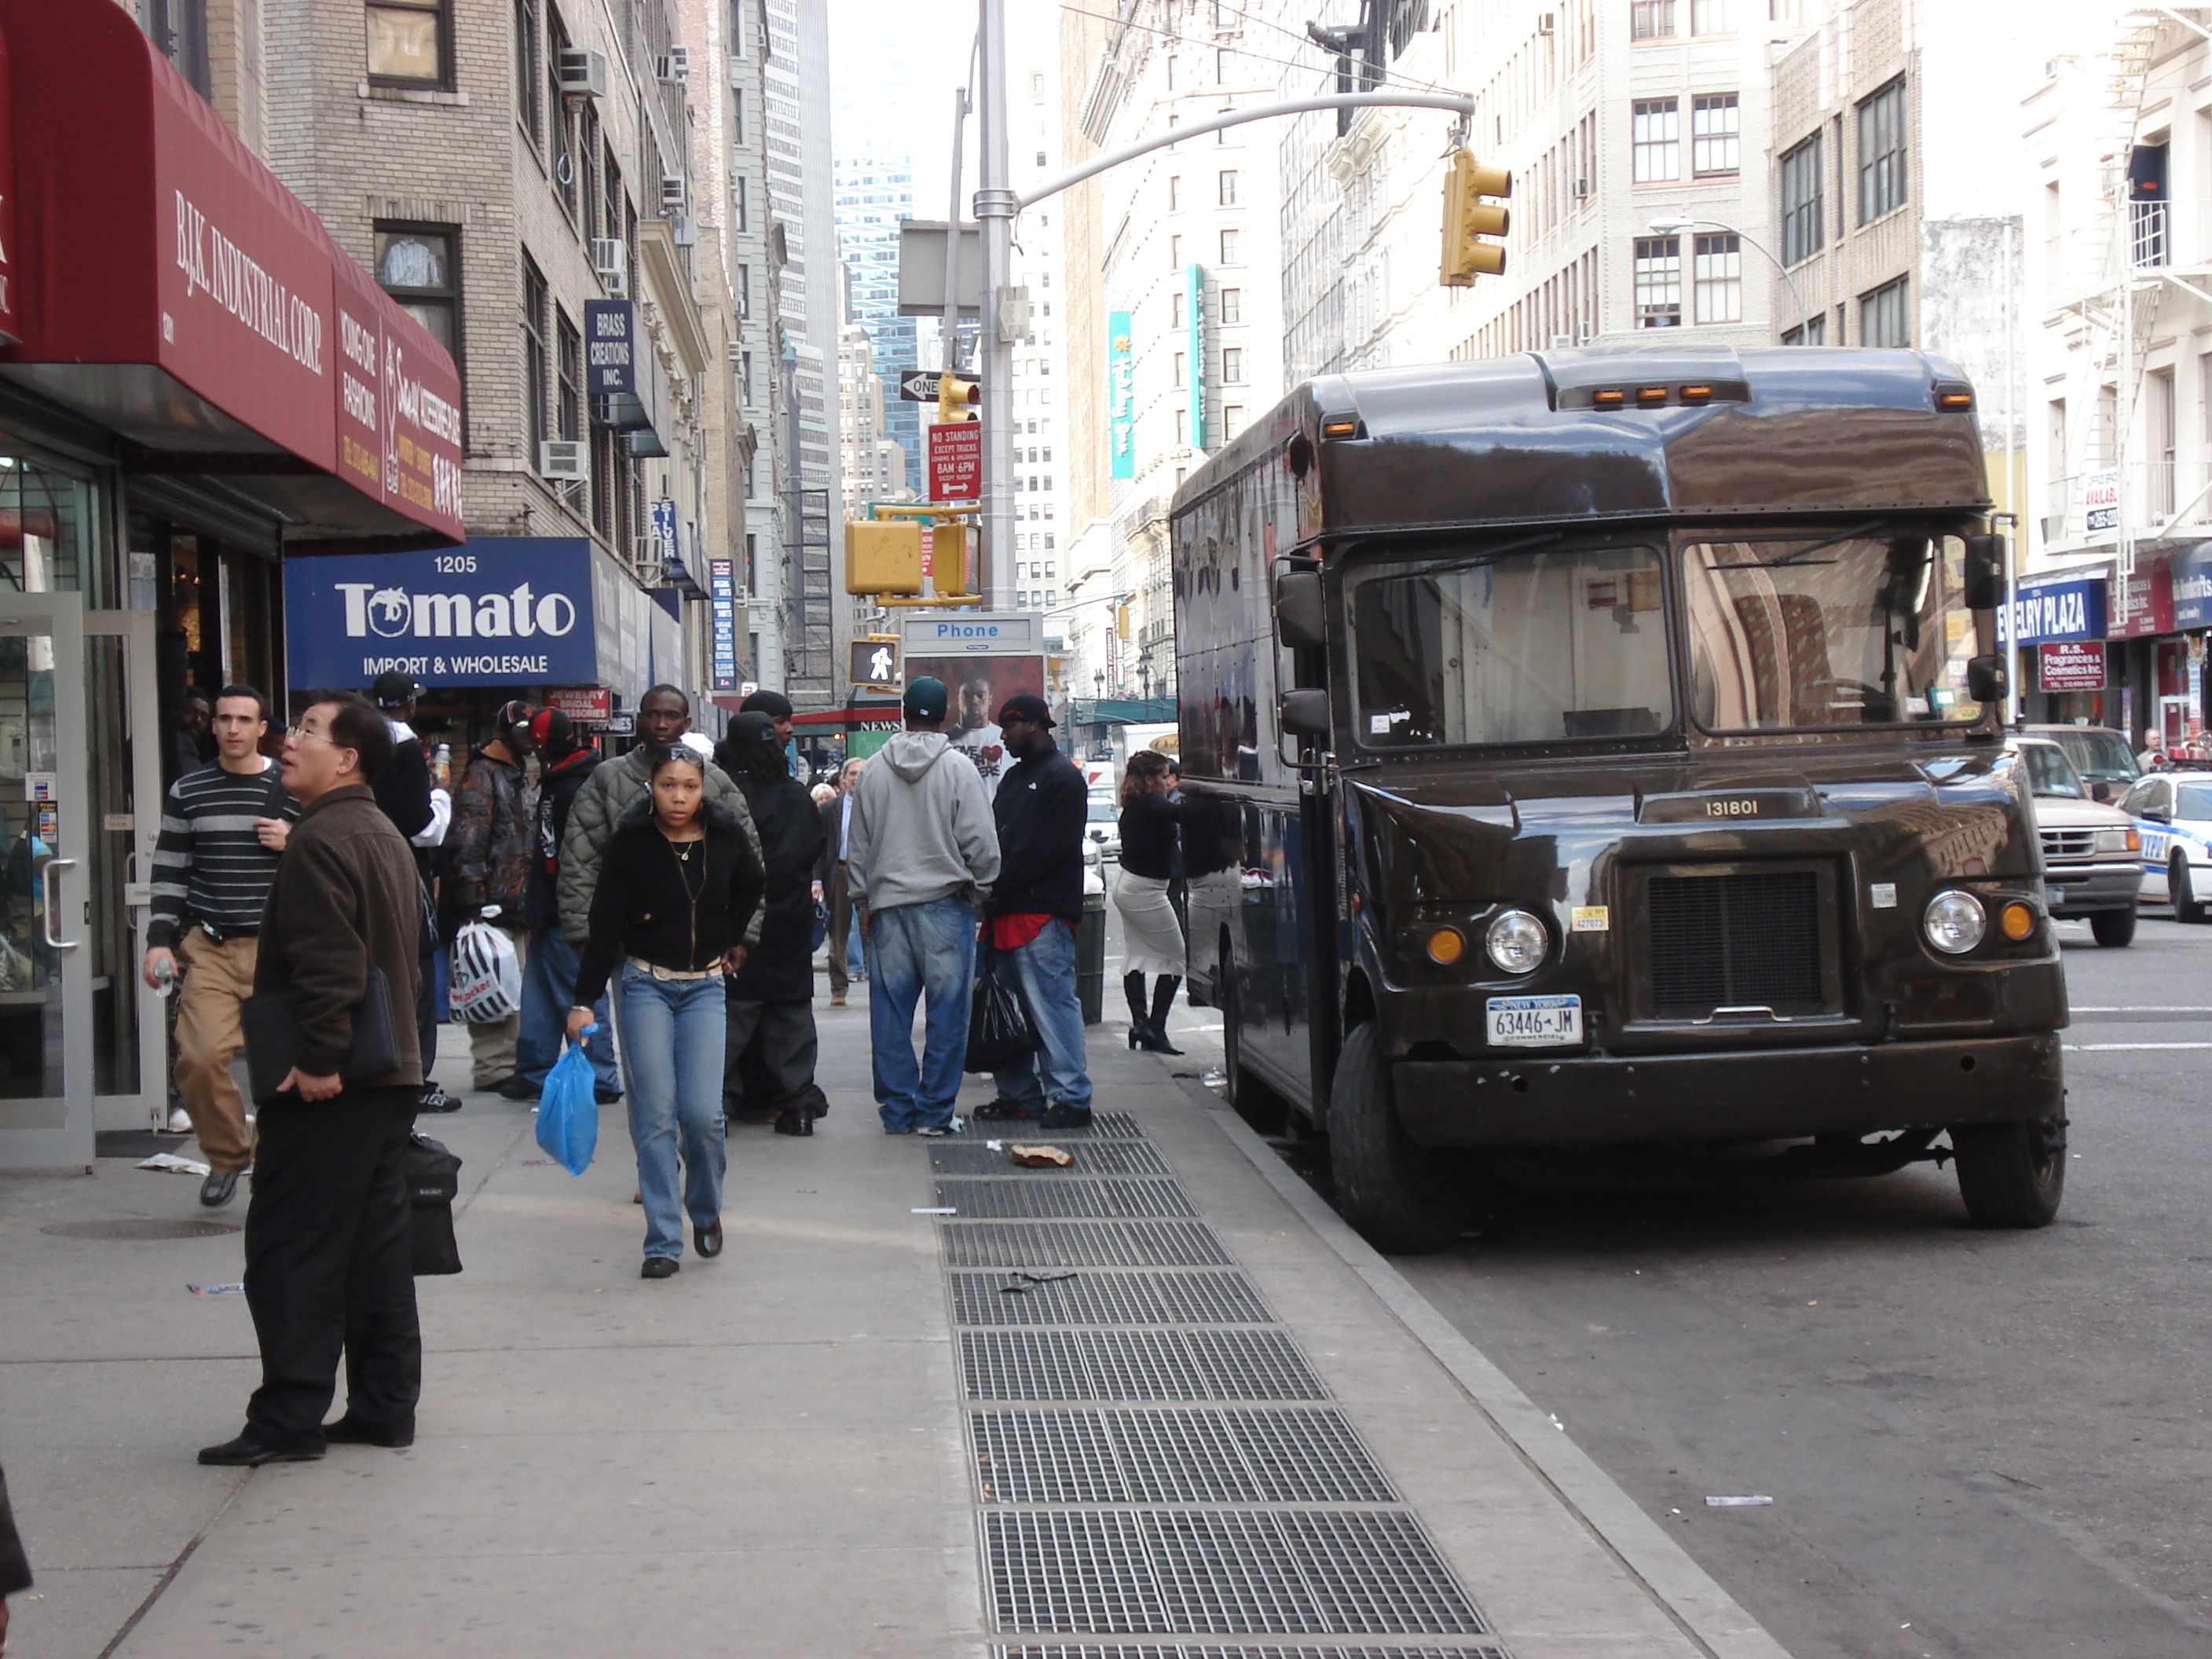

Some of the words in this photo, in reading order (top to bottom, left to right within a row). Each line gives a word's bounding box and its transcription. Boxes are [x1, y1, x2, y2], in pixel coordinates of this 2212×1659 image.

[211, 225, 290, 353] INDUSTRIAL
[596, 313, 626, 337] BRASS
[590, 341, 630, 365] CREATIONS
[602, 368, 624, 386] INC.
[914, 380, 939, 393] ONE
[932, 432, 943, 443] NO
[945, 430, 979, 442] STANDING
[934, 445, 954, 454] EXCEPT
[956, 443, 976, 452] TRUCKS
[2105, 471, 2119, 483] SPAC
[2086, 487, 2118, 506] AVAILABL
[661, 503, 676, 558] SILVER
[434, 555, 478, 573] 1205
[334, 581, 576, 638] Tomato
[2044, 591, 2086, 635] PLAZA
[937, 624, 998, 638] Phone
[2060, 644, 2085, 654] R.S.
[363, 657, 429, 676] IMPORT
[433, 657, 446, 674] &
[451, 655, 548, 674] WHOLESALE
[2044, 654, 2094, 667] Fragrances
[2094, 654, 2101, 663] &
[2044, 665, 2088, 676] Cosmetics
[2088, 664, 2102, 675] Inc.
[550, 690, 605, 700] JEWELRY
[560, 699, 594, 709] BRIDAL
[587, 716, 632, 731] PERFUMES
[860, 720, 901, 731] NEWS
[1706, 800, 1758, 816] 131801
[1511, 1000, 1531, 1010] NEW
